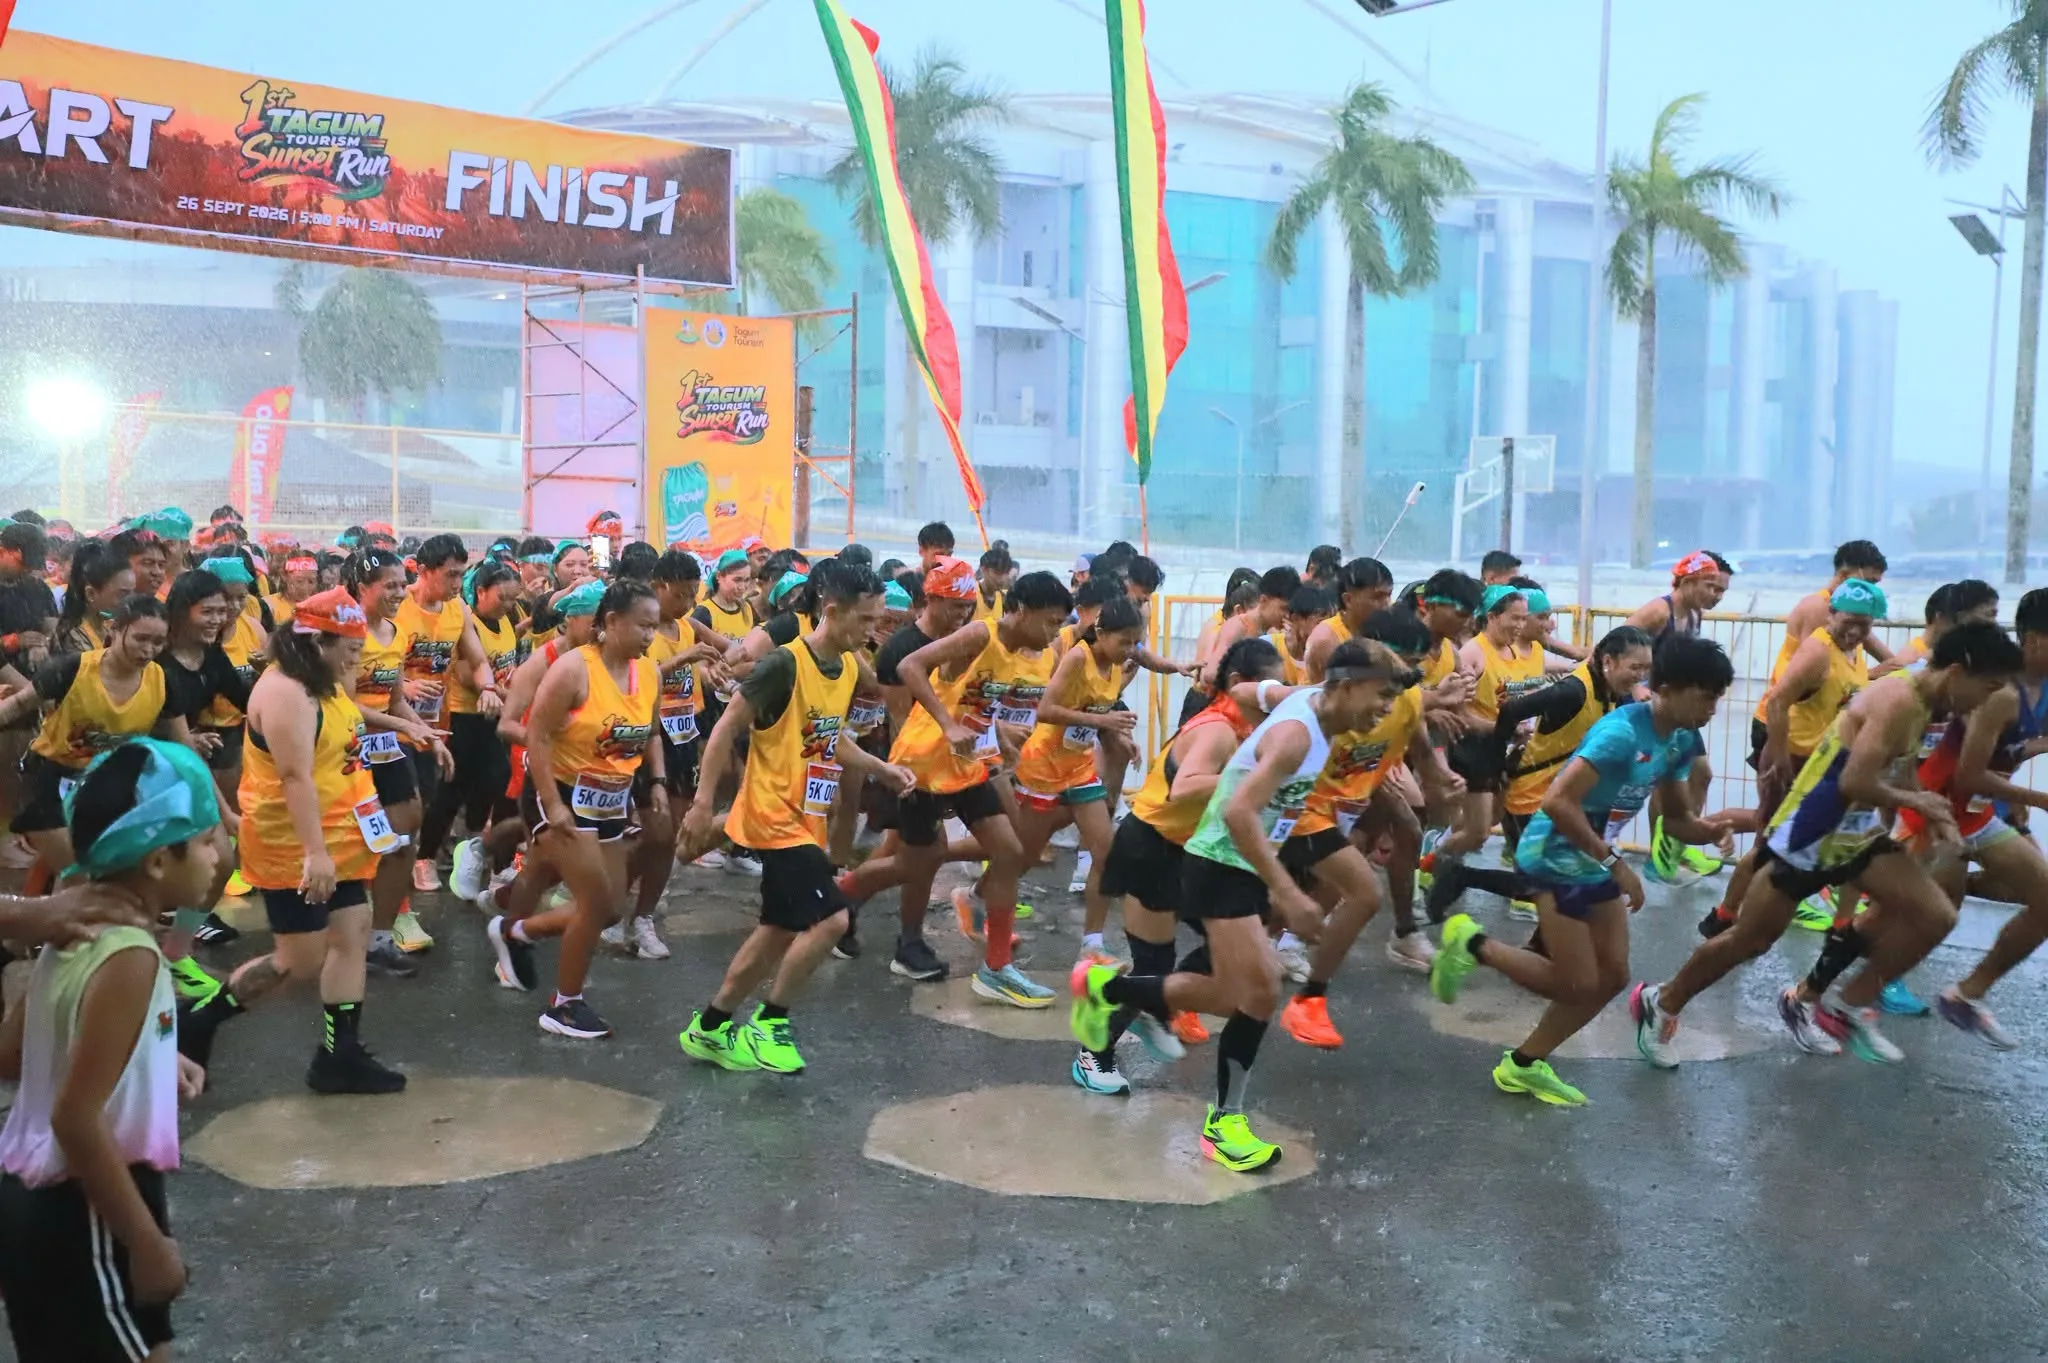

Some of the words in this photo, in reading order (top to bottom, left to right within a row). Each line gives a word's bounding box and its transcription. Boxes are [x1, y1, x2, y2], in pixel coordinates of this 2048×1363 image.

[236, 80, 296, 137] 1st
[0, 79, 175, 170] ART
[266, 108, 385, 137] TAGUM
[286, 134, 361, 147] TOURISM
[238, 132, 344, 181] Sunset
[335, 149, 391, 187] Run
[446, 150, 681, 236] FINISH
[177, 196, 199, 211] 26
[203, 199, 244, 217] SEPT
[248, 207, 289, 221] 2026
[336, 215, 360, 229] PM
[369, 220, 444, 240] SATURDAY
[733, 326, 760, 337] Tagum
[677, 369, 714, 410] 1st
[695, 386, 766, 405] TAGUM
[707, 402, 752, 411] TOURISM
[677, 403, 741, 438] Sunset
[735, 409, 769, 436] Run
[1072, 726, 1090, 742] 5K
[577, 788, 596, 806] 5K
[808, 781, 823, 801] 5K
[369, 817, 388, 837] 5K
